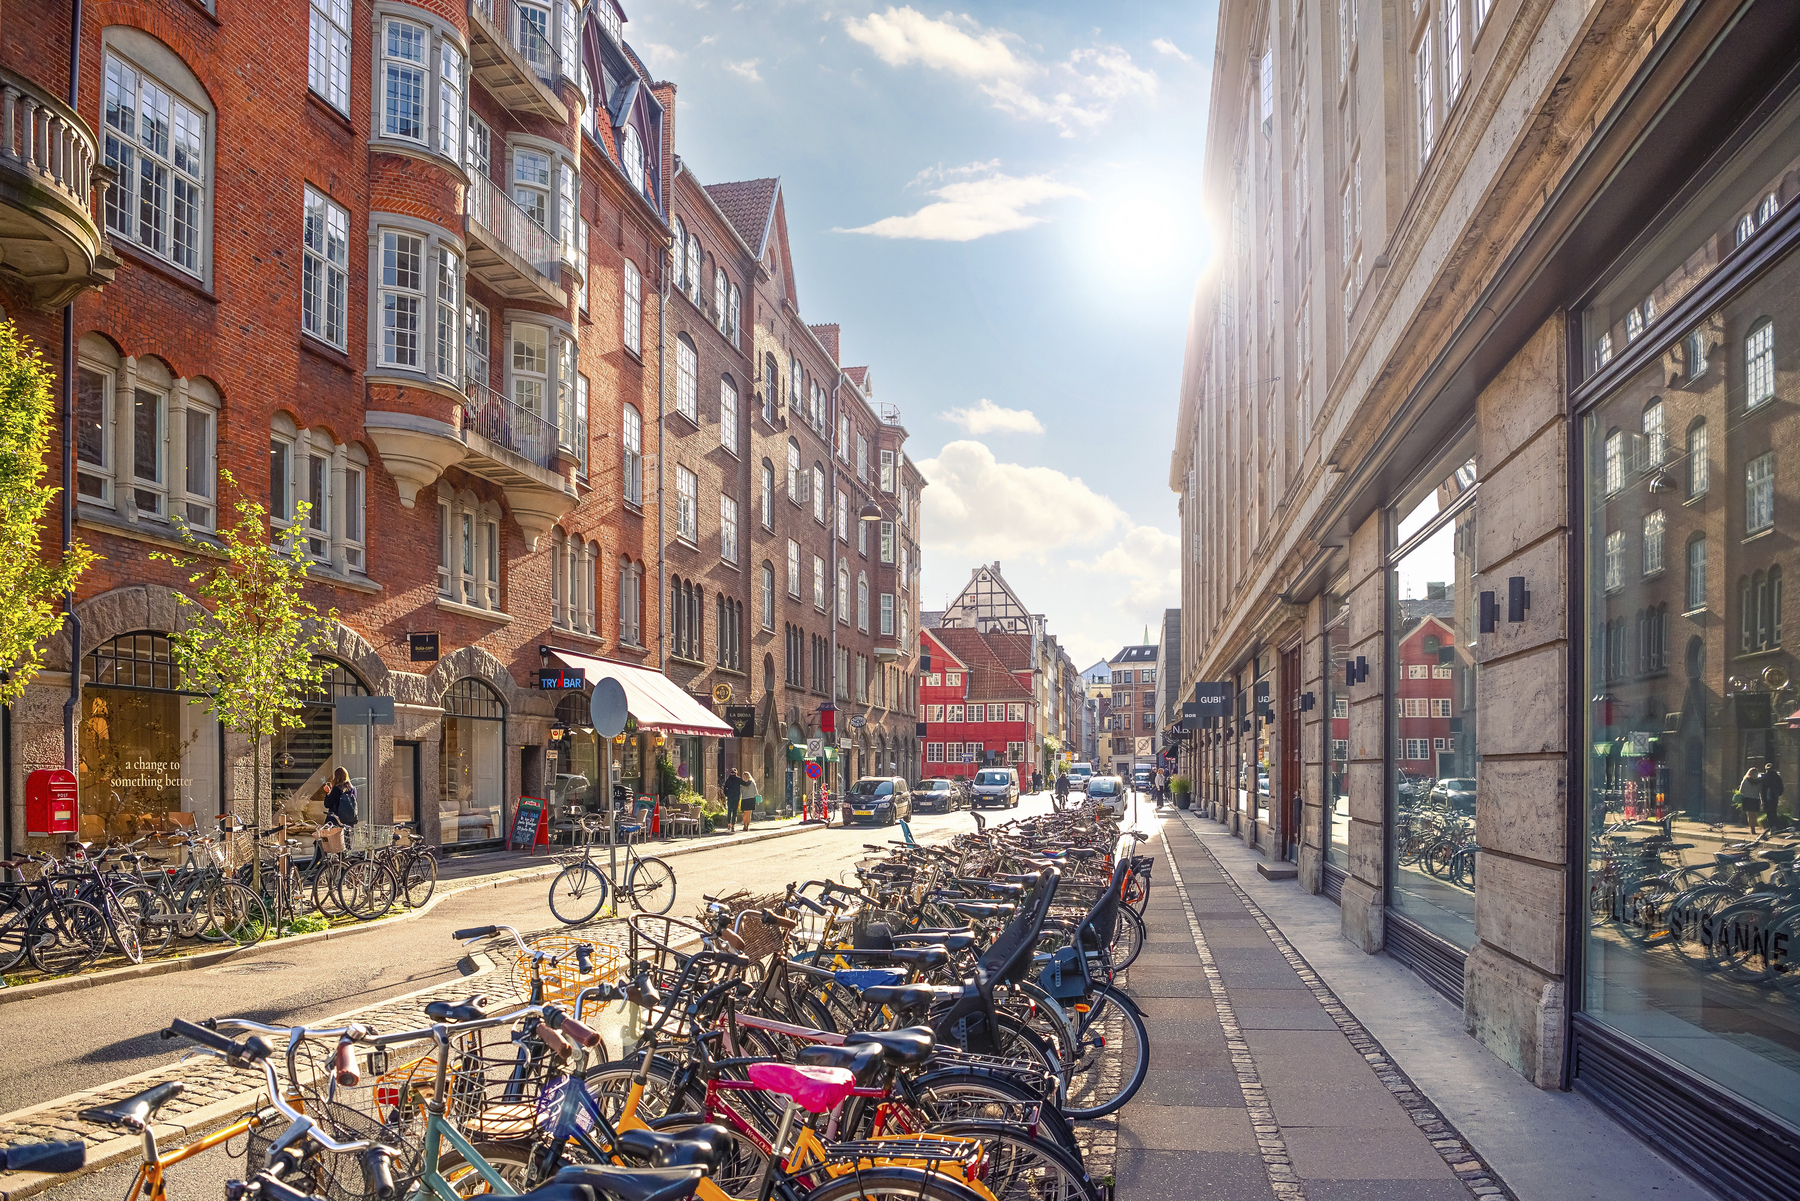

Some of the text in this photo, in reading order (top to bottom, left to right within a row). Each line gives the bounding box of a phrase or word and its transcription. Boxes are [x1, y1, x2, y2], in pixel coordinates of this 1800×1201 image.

[126, 756, 180, 774] a change to
[110, 774, 194, 790] something better
[9, 903, 35, 928] RALEIGH
[1670, 906, 1789, 973] SUSANNE
